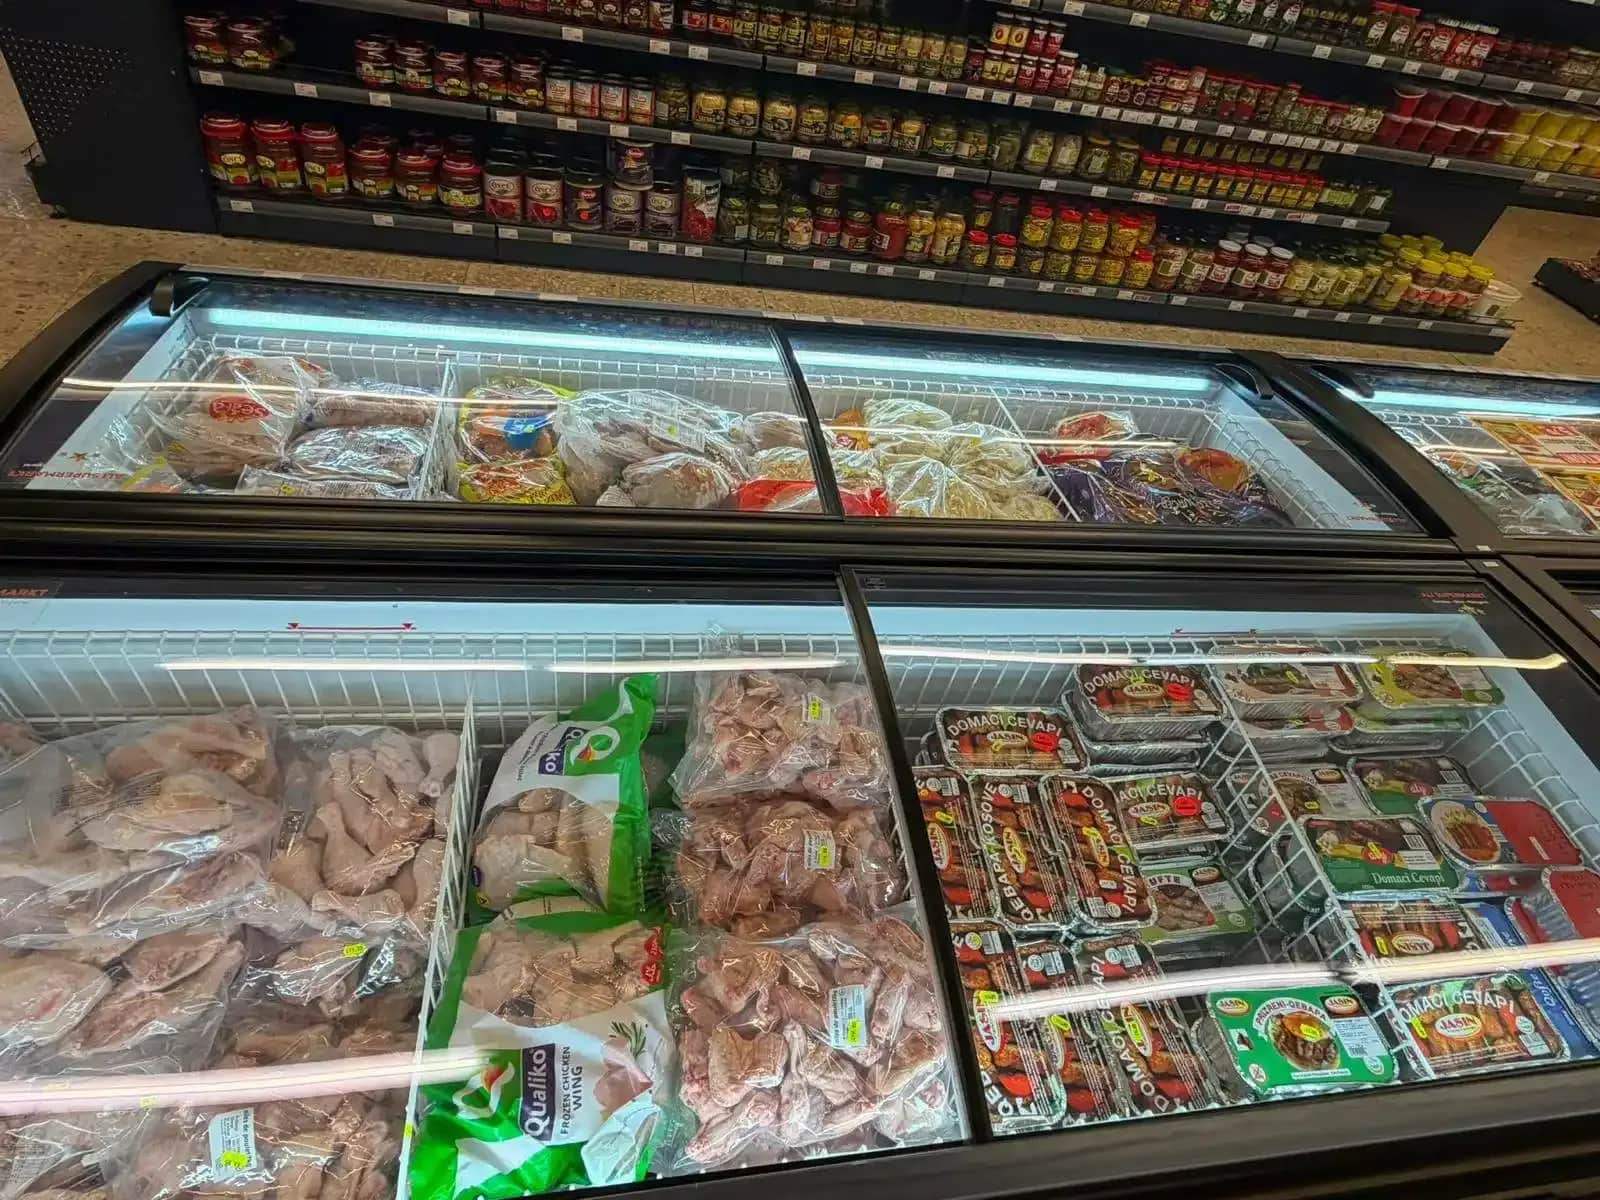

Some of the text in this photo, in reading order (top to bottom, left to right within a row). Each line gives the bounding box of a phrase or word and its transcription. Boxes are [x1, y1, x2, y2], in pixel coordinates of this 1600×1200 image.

[1401, 991, 1446, 1023] OMACI
[1439, 1014, 1481, 1030] JASIN
[524, 1049, 547, 1138] Qualiko
[560, 1046, 571, 1136] FROZEN CHICKEN
[572, 1065, 584, 1112] WING
